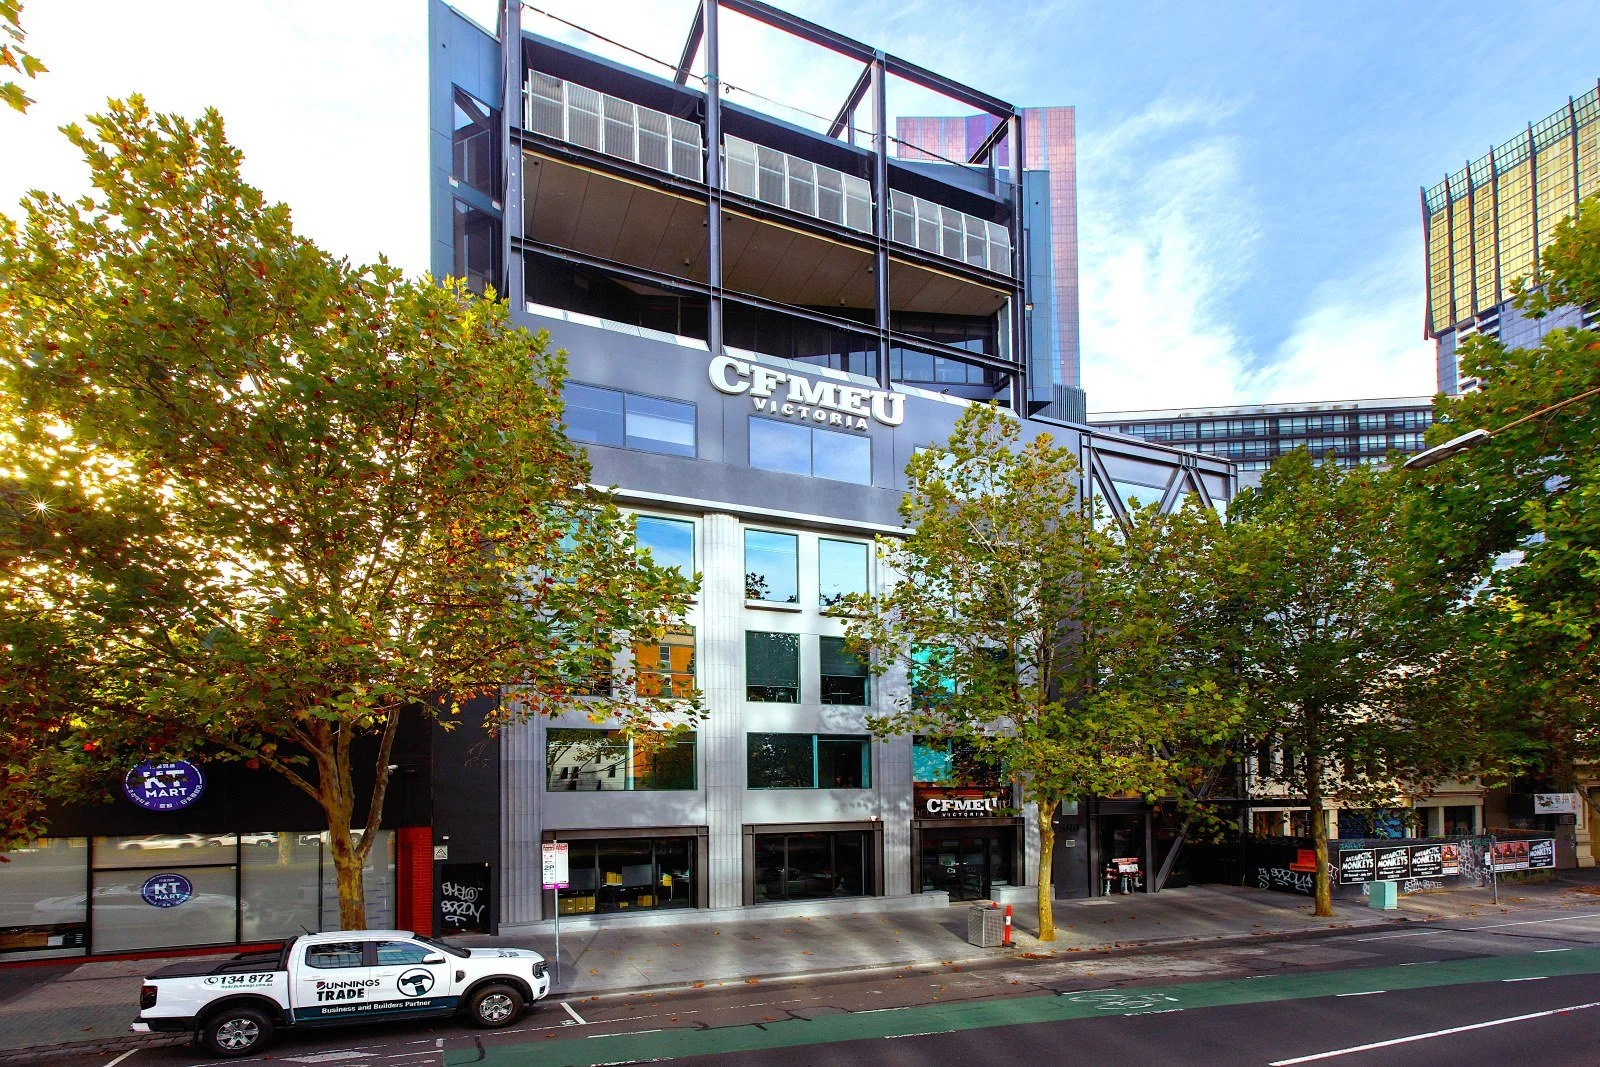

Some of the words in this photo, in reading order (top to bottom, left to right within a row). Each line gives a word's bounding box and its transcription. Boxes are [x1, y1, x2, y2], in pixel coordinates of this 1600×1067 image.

[708, 355, 906, 427] CFMEU
[752, 397, 869, 431] VICTORIA
[145, 788, 187, 798] MART
[926, 797, 998, 813] CFMEU
[1341, 859, 1374, 870] MONKEYS
[1377, 856, 1408, 868] MONKEYS
[1411, 854, 1441, 864] MONKEYS
[154, 882, 181, 895] KT
[154, 893, 181, 901] MART
[220, 975, 244, 985] 134
[248, 973, 274, 983] 872
[315, 979, 381, 991] BUNNINGS
[316, 988, 365, 1002] TRADE
[321, 1006, 356, 1014] Business
[373, 1001, 404, 1009] Builders
